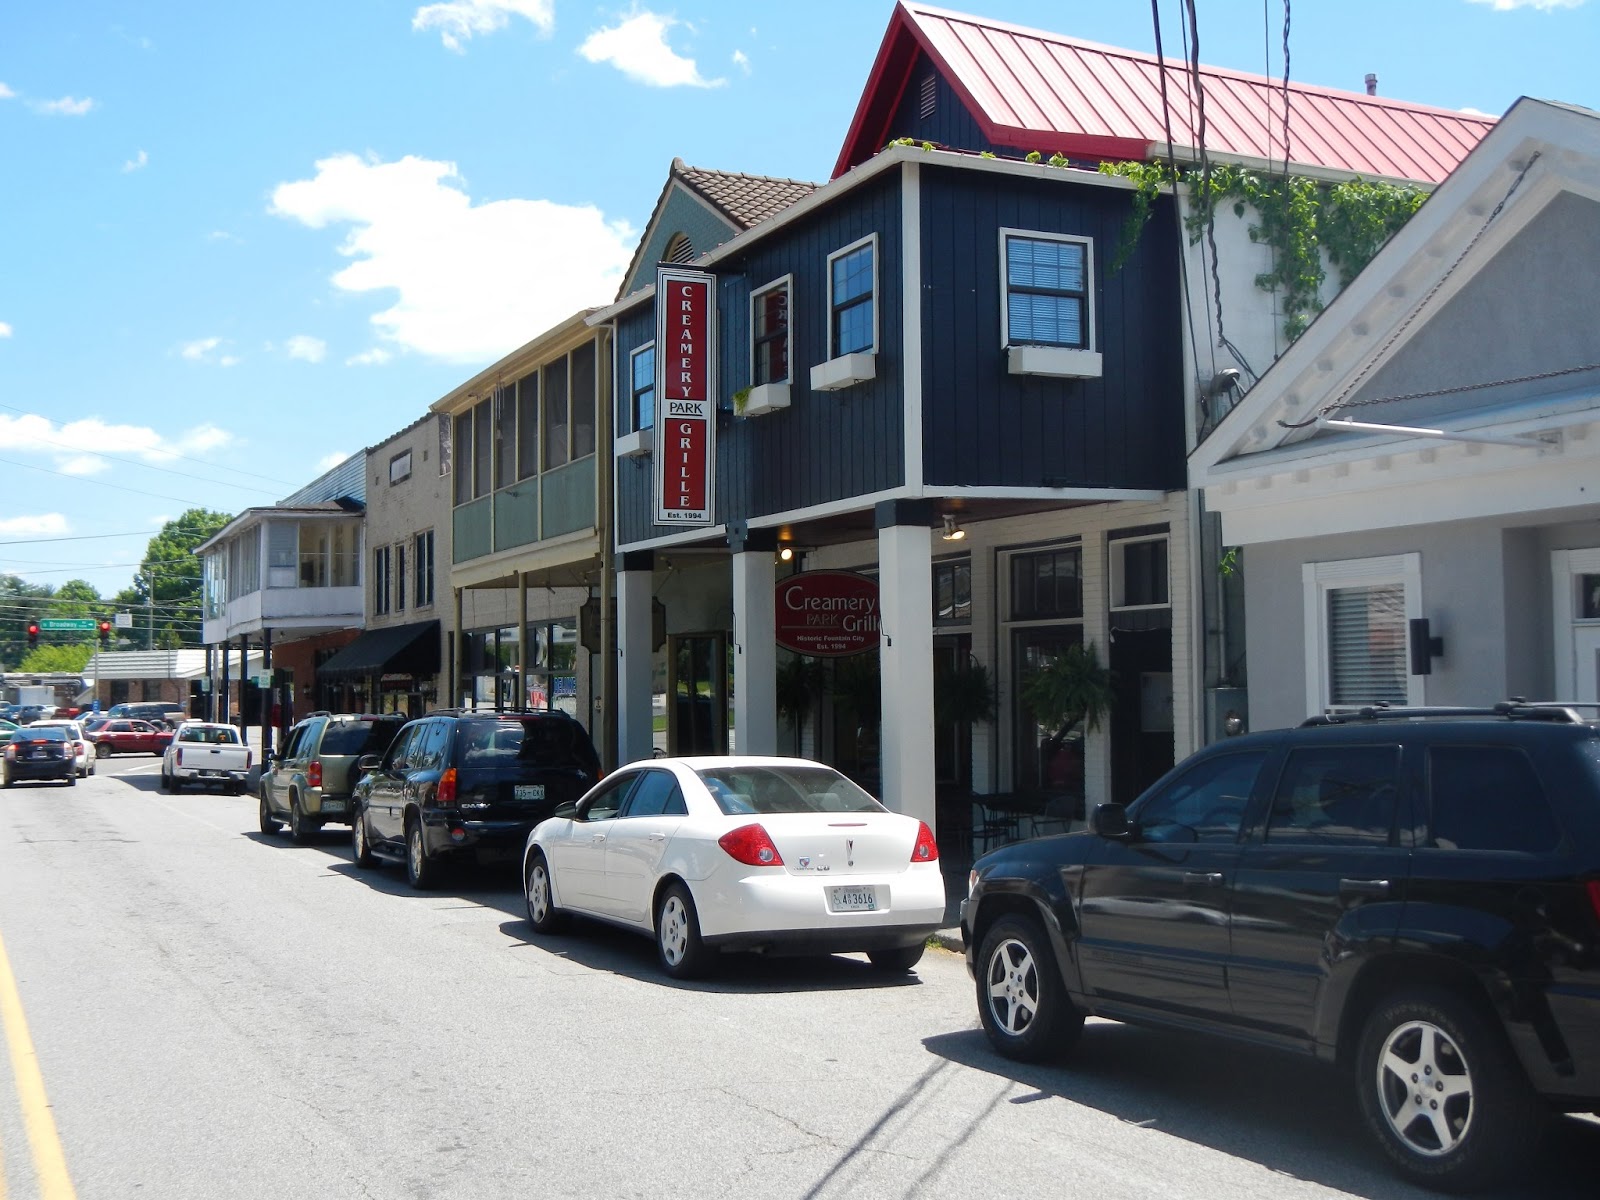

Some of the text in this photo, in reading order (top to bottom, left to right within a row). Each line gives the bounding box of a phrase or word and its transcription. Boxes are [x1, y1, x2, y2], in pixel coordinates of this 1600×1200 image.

[680, 286, 693, 397] CREAMERY
[669, 402, 703, 414] PARK
[679, 423, 692, 507] GRILLE
[785, 585, 875, 614] Creamery
[807, 613, 839, 625] PARK
